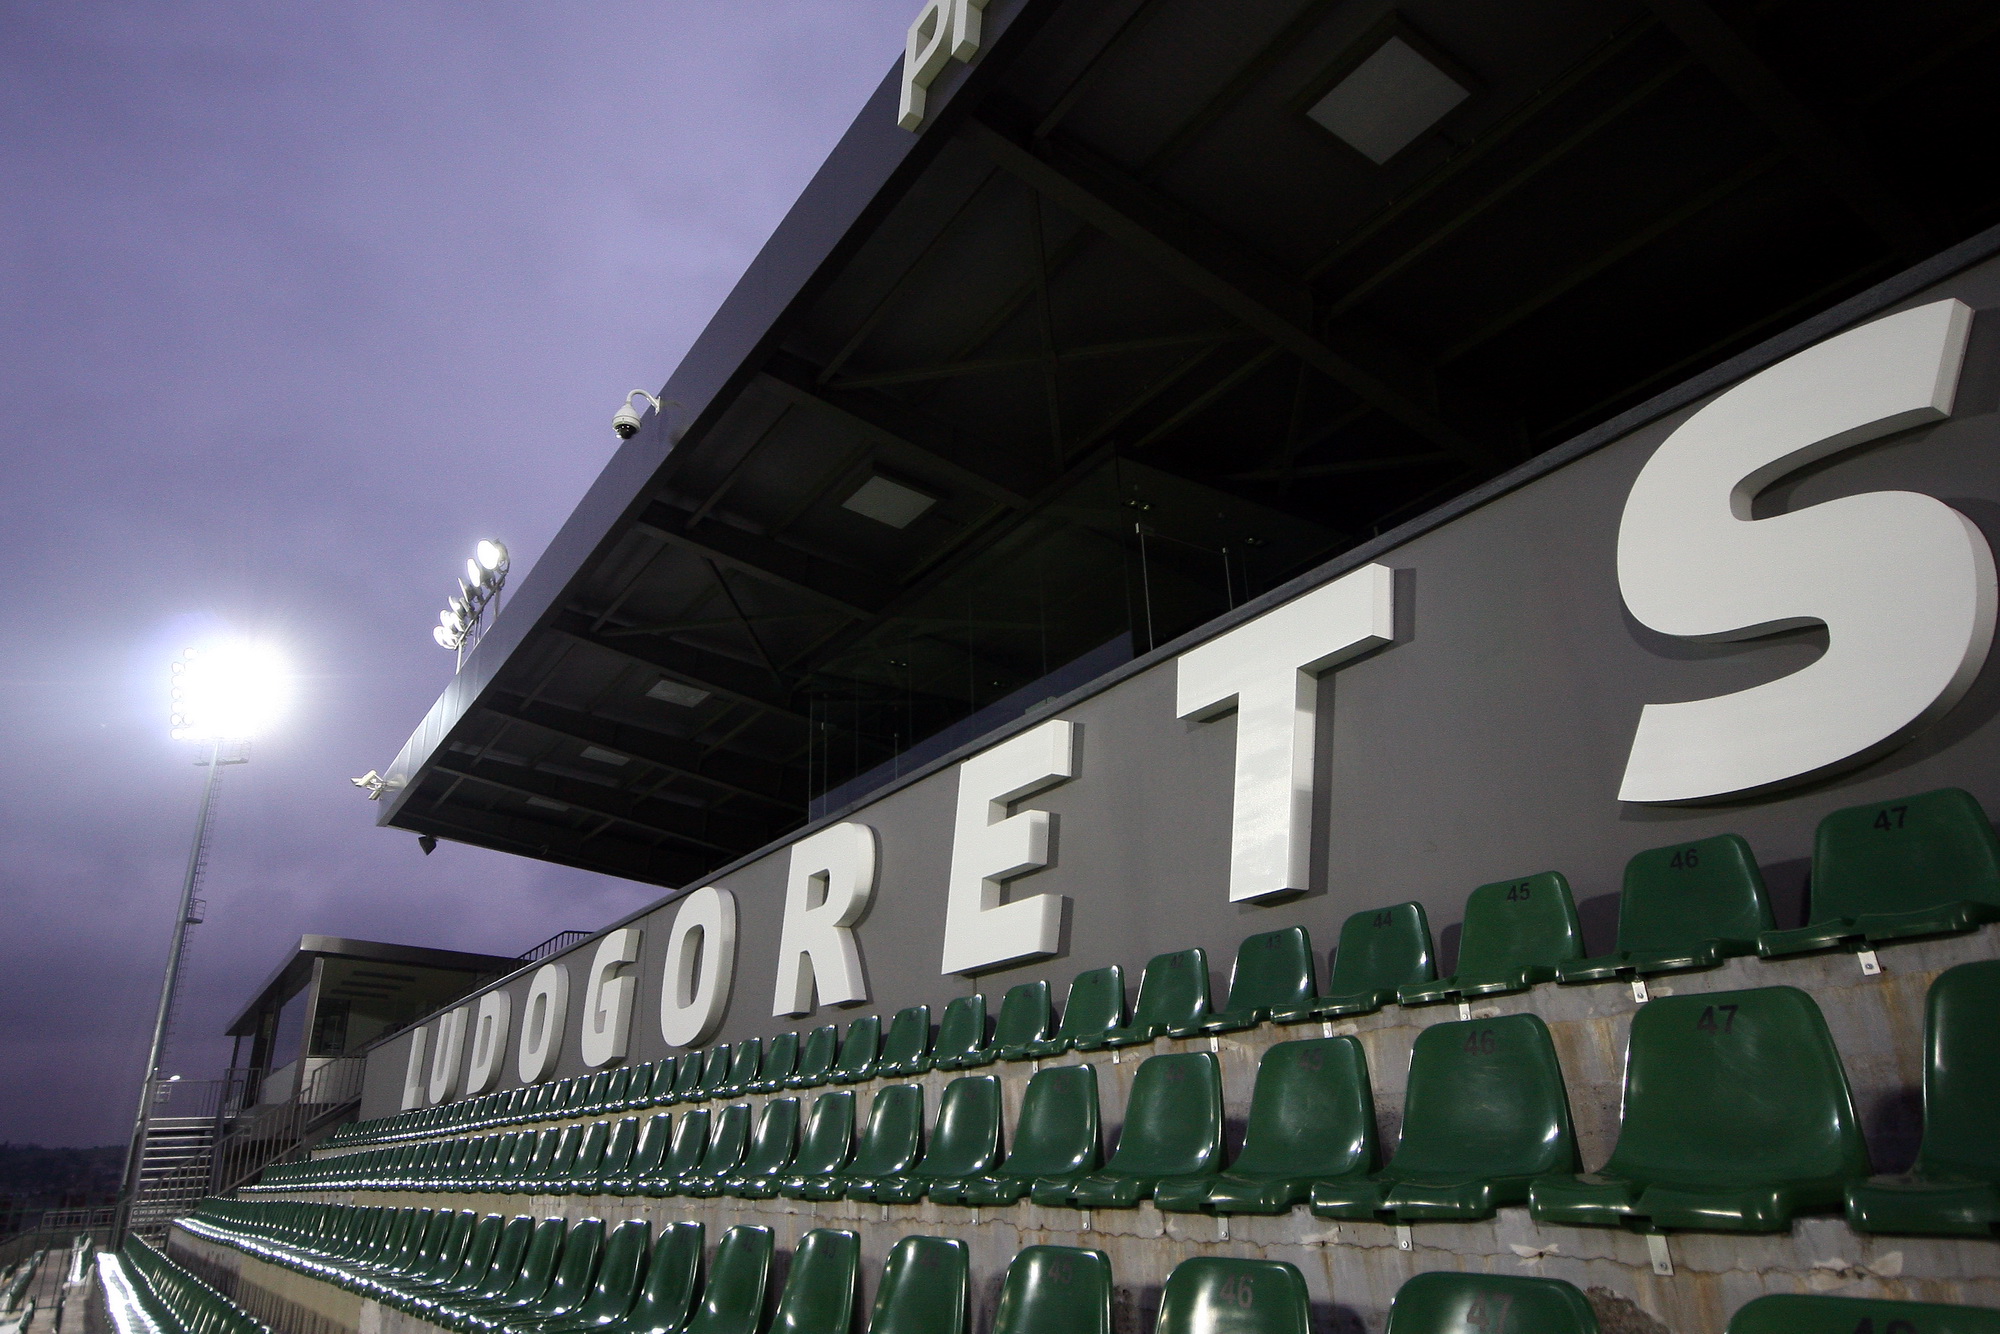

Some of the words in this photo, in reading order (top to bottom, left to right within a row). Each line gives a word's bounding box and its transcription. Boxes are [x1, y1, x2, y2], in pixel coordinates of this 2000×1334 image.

[401, 297, 1999, 1111] LUDOGORETS
[1873, 806, 1909, 832] 47
[1670, 849, 1699, 871] 46
[1506, 882, 1531, 902] 45
[1372, 911, 1393, 929] 44
[1697, 1004, 1740, 1036] 47
[1463, 1029, 1497, 1057] 46
[1300, 1048, 1324, 1073] 45
[1048, 1254, 1074, 1285] 45
[1219, 1273, 1254, 1310] 46
[1466, 1290, 1514, 1334] 47
